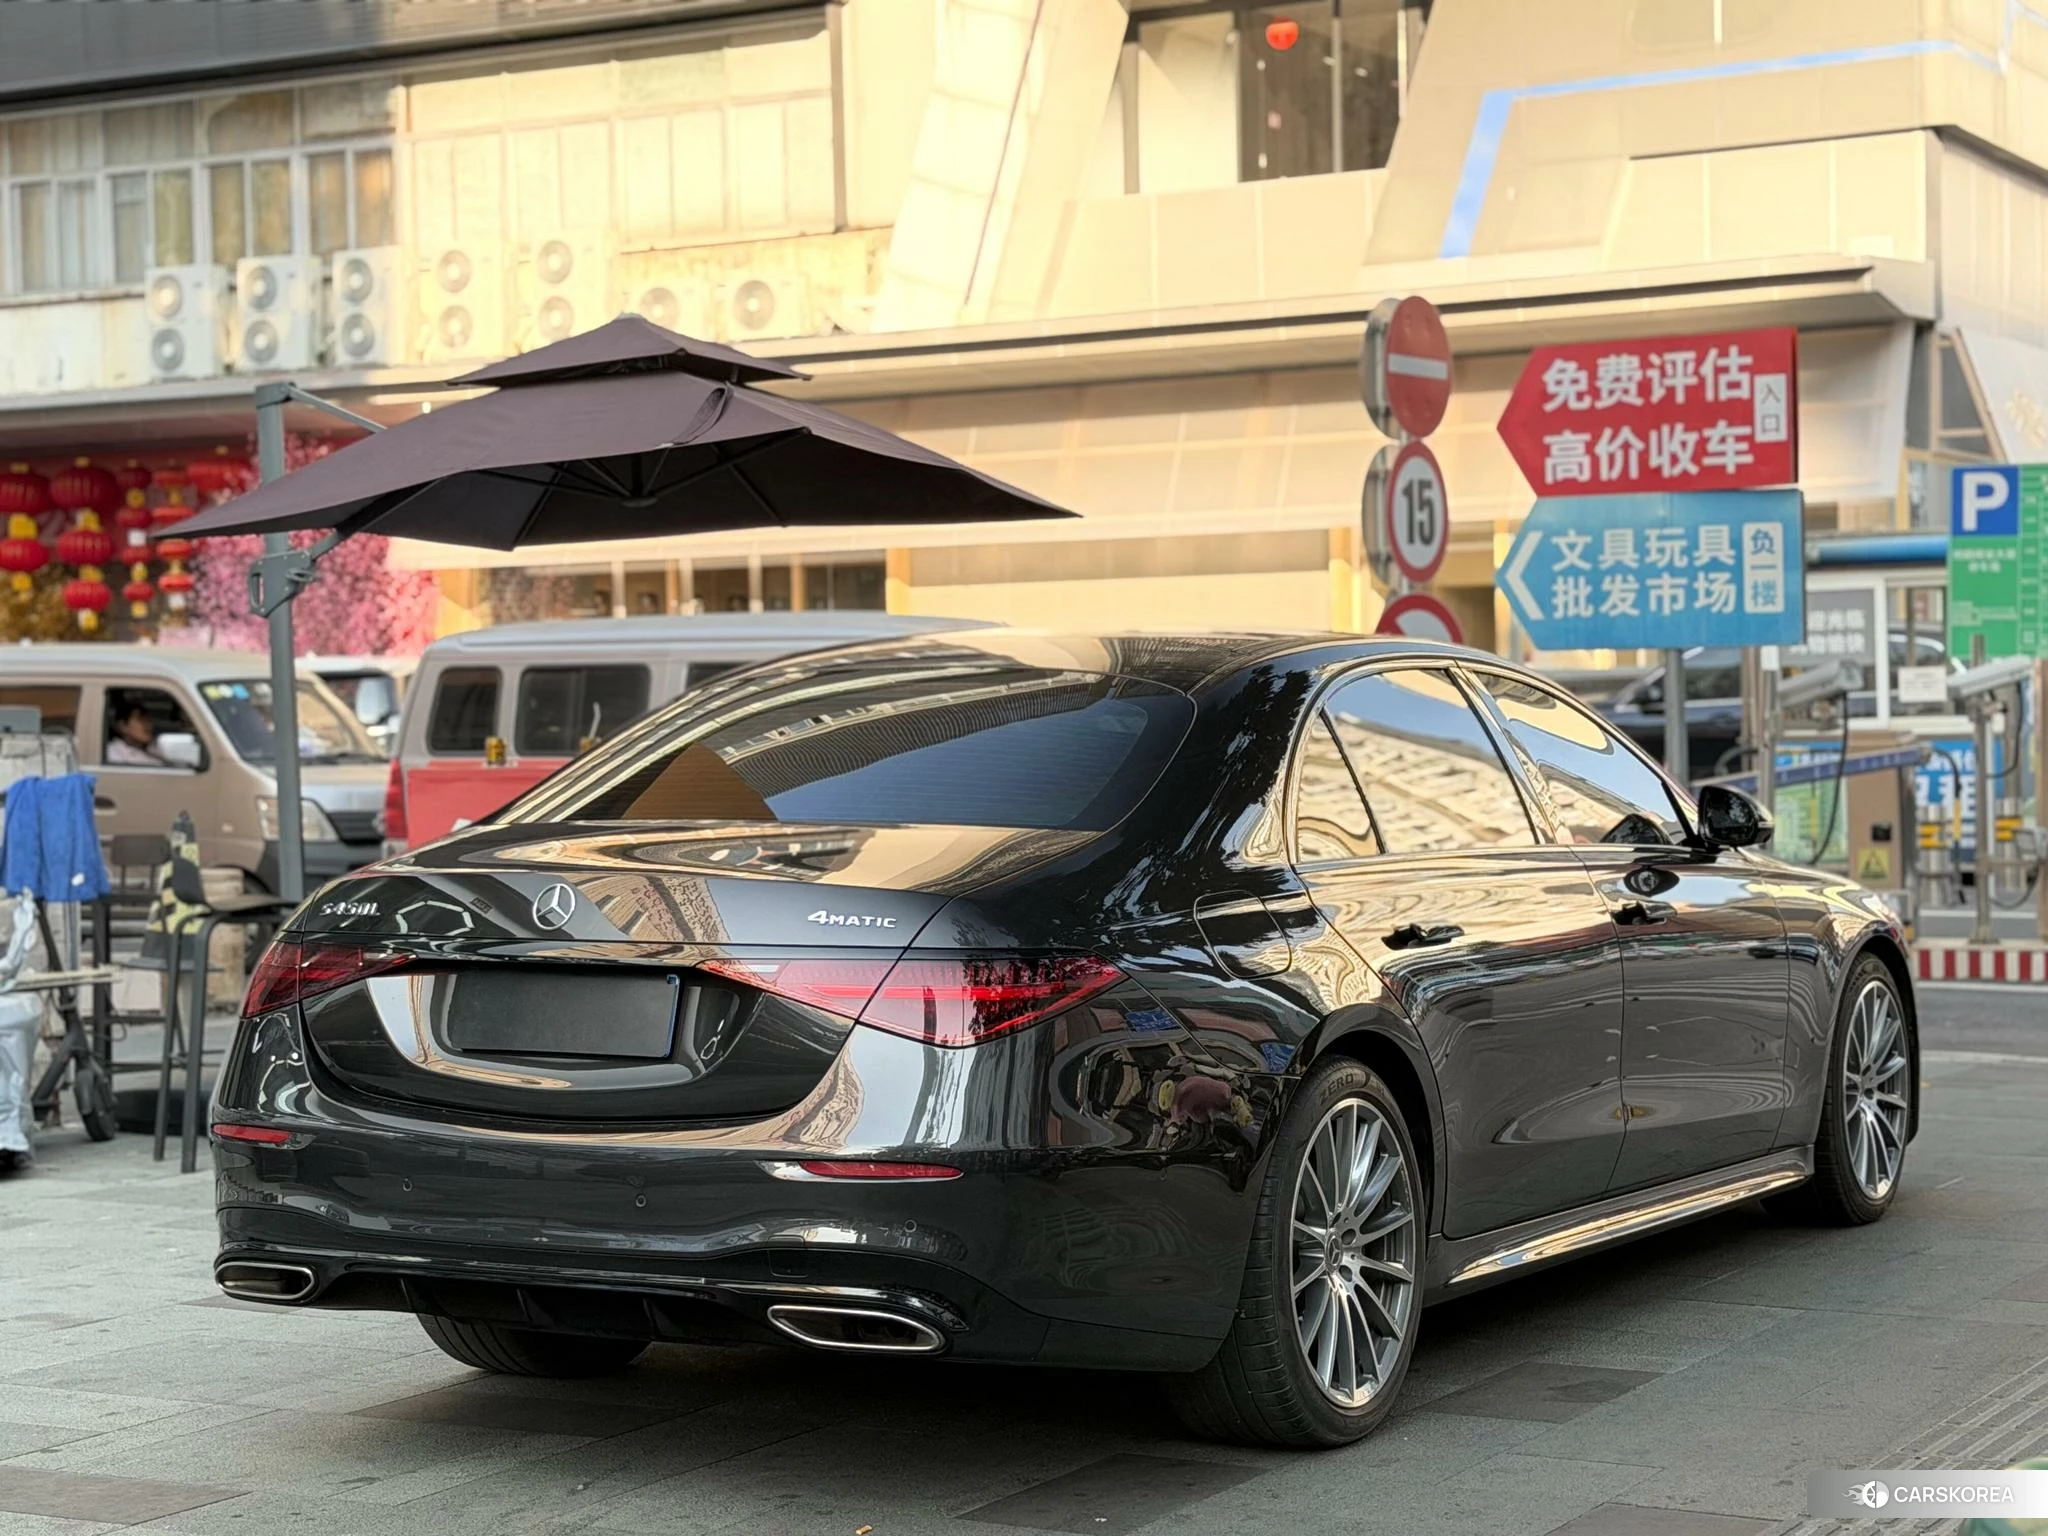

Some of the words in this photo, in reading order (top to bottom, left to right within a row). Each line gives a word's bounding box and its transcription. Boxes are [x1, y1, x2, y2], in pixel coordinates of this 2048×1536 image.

[1542, 345, 1753, 412] 免费评估
[1759, 382, 1783, 434] 入口
[1542, 420, 1754, 484] 高价收车
[1401, 478, 1435, 547] 15
[1962, 471, 2010, 532] P
[1552, 525, 1736, 571] 文具玩具
[1750, 528, 1778, 608] 负一楼
[1552, 573, 1737, 619] 批发市场
[807, 910, 897, 928] 4MATIC
